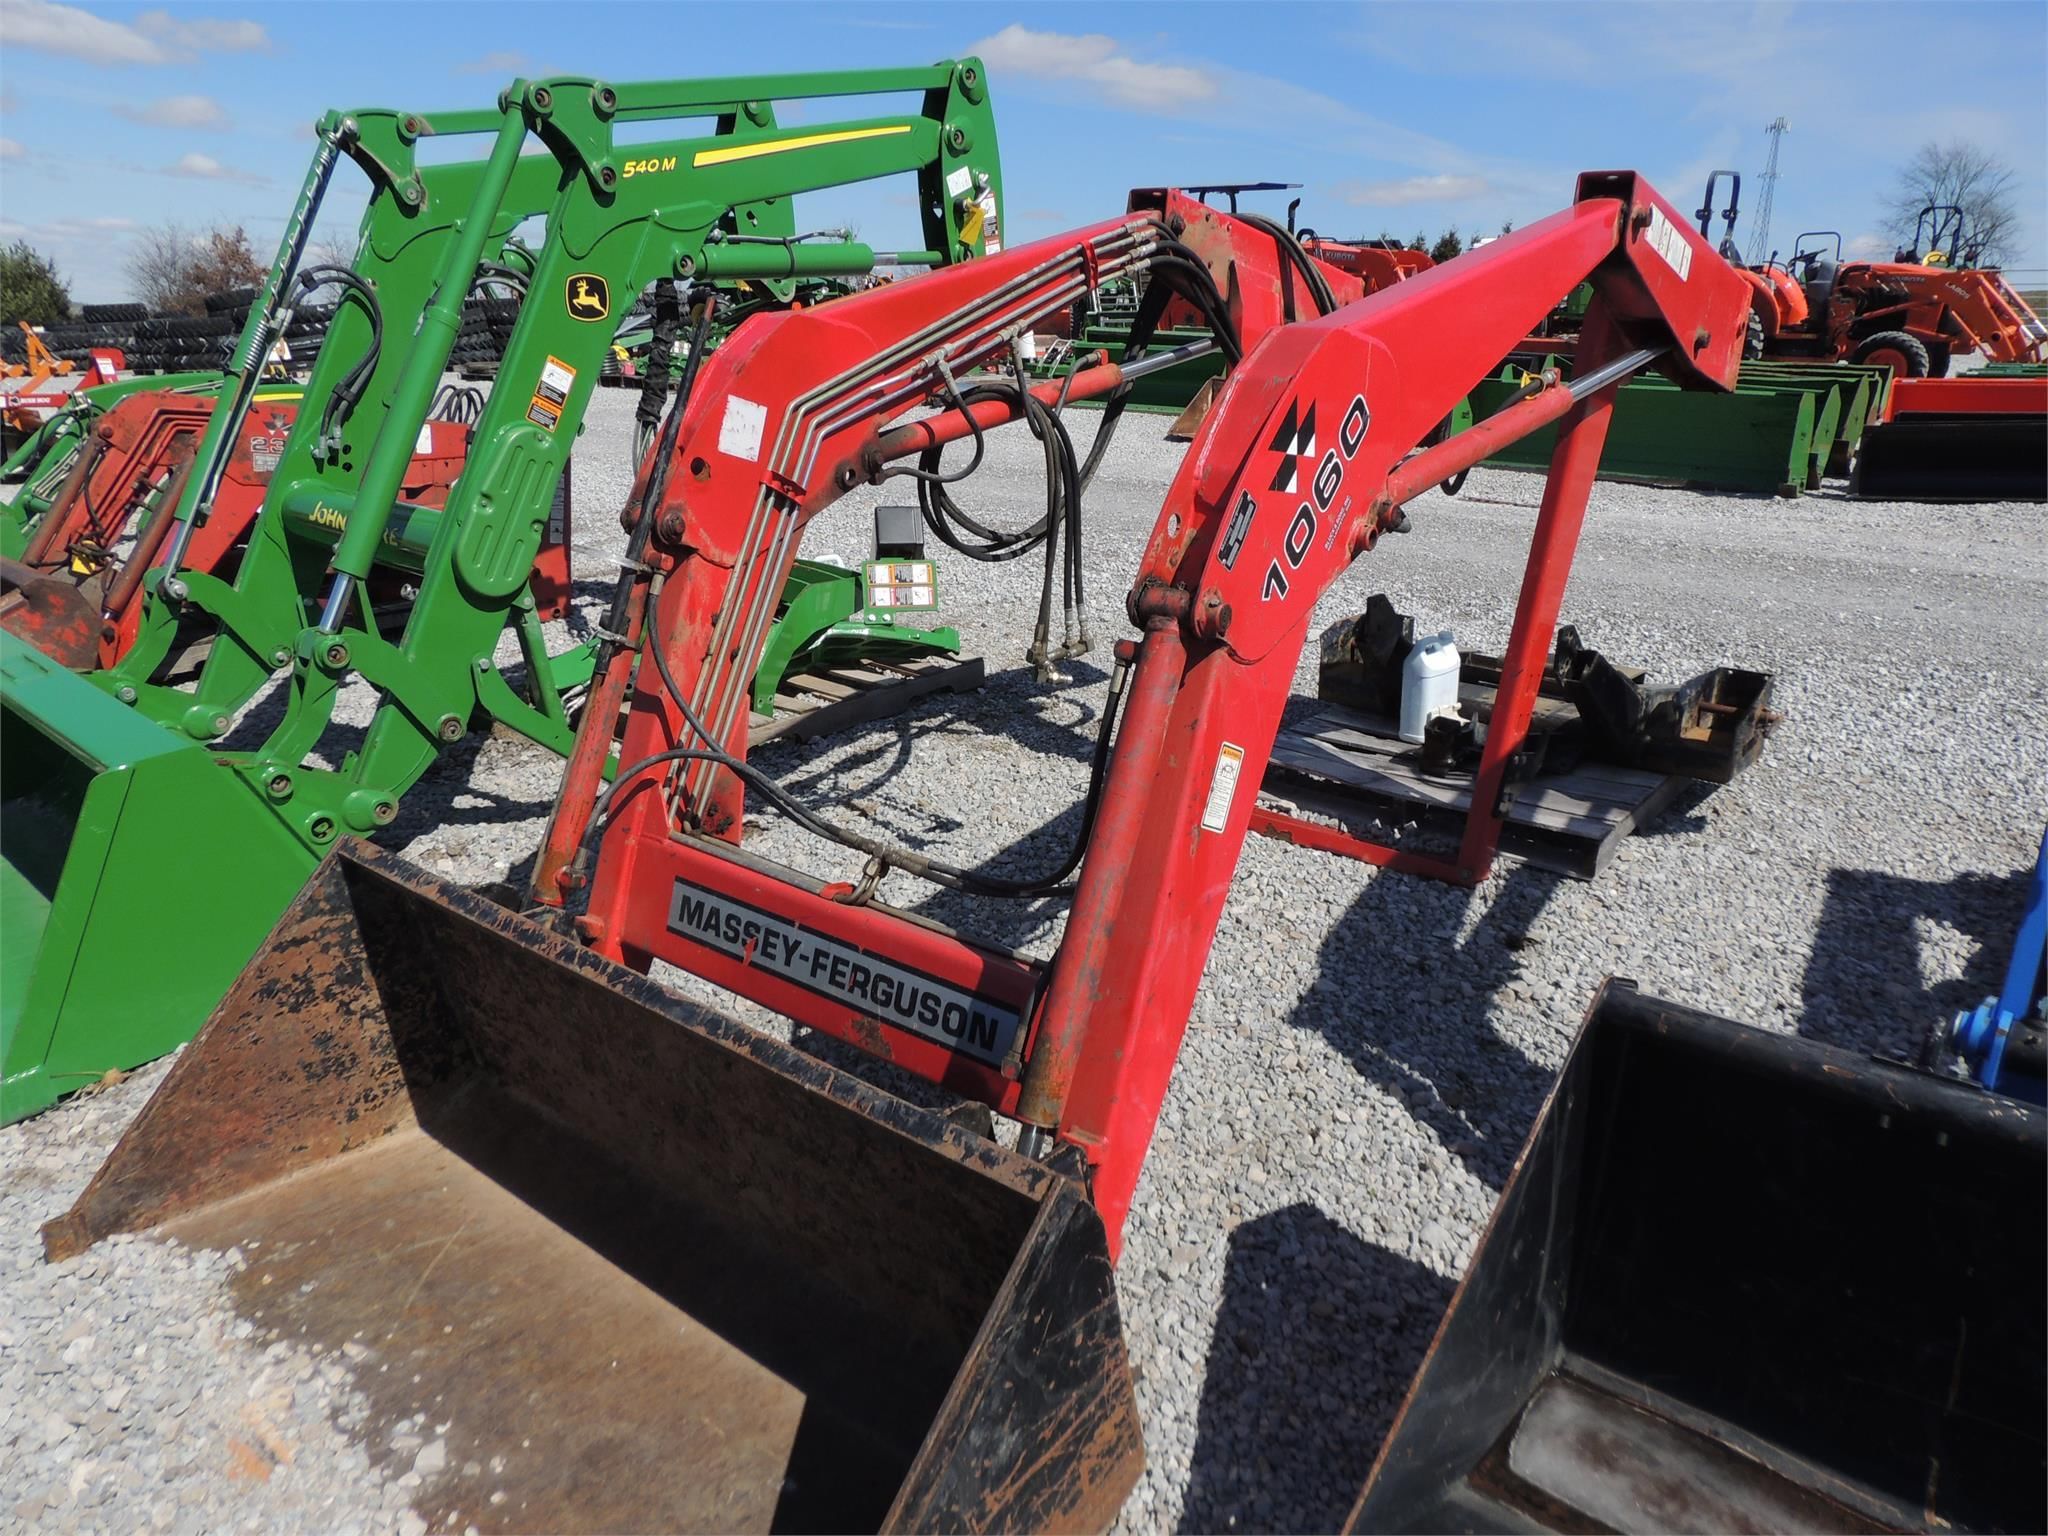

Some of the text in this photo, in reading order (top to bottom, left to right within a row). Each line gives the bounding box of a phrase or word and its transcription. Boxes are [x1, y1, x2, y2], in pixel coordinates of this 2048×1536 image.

[622, 156, 677, 178] 540 M
[250, 436, 287, 455] 23
[1261, 393, 1371, 602] 1060
[308, 500, 348, 531] JOHN
[678, 894, 999, 1052] MASSEY-FERGUSON
